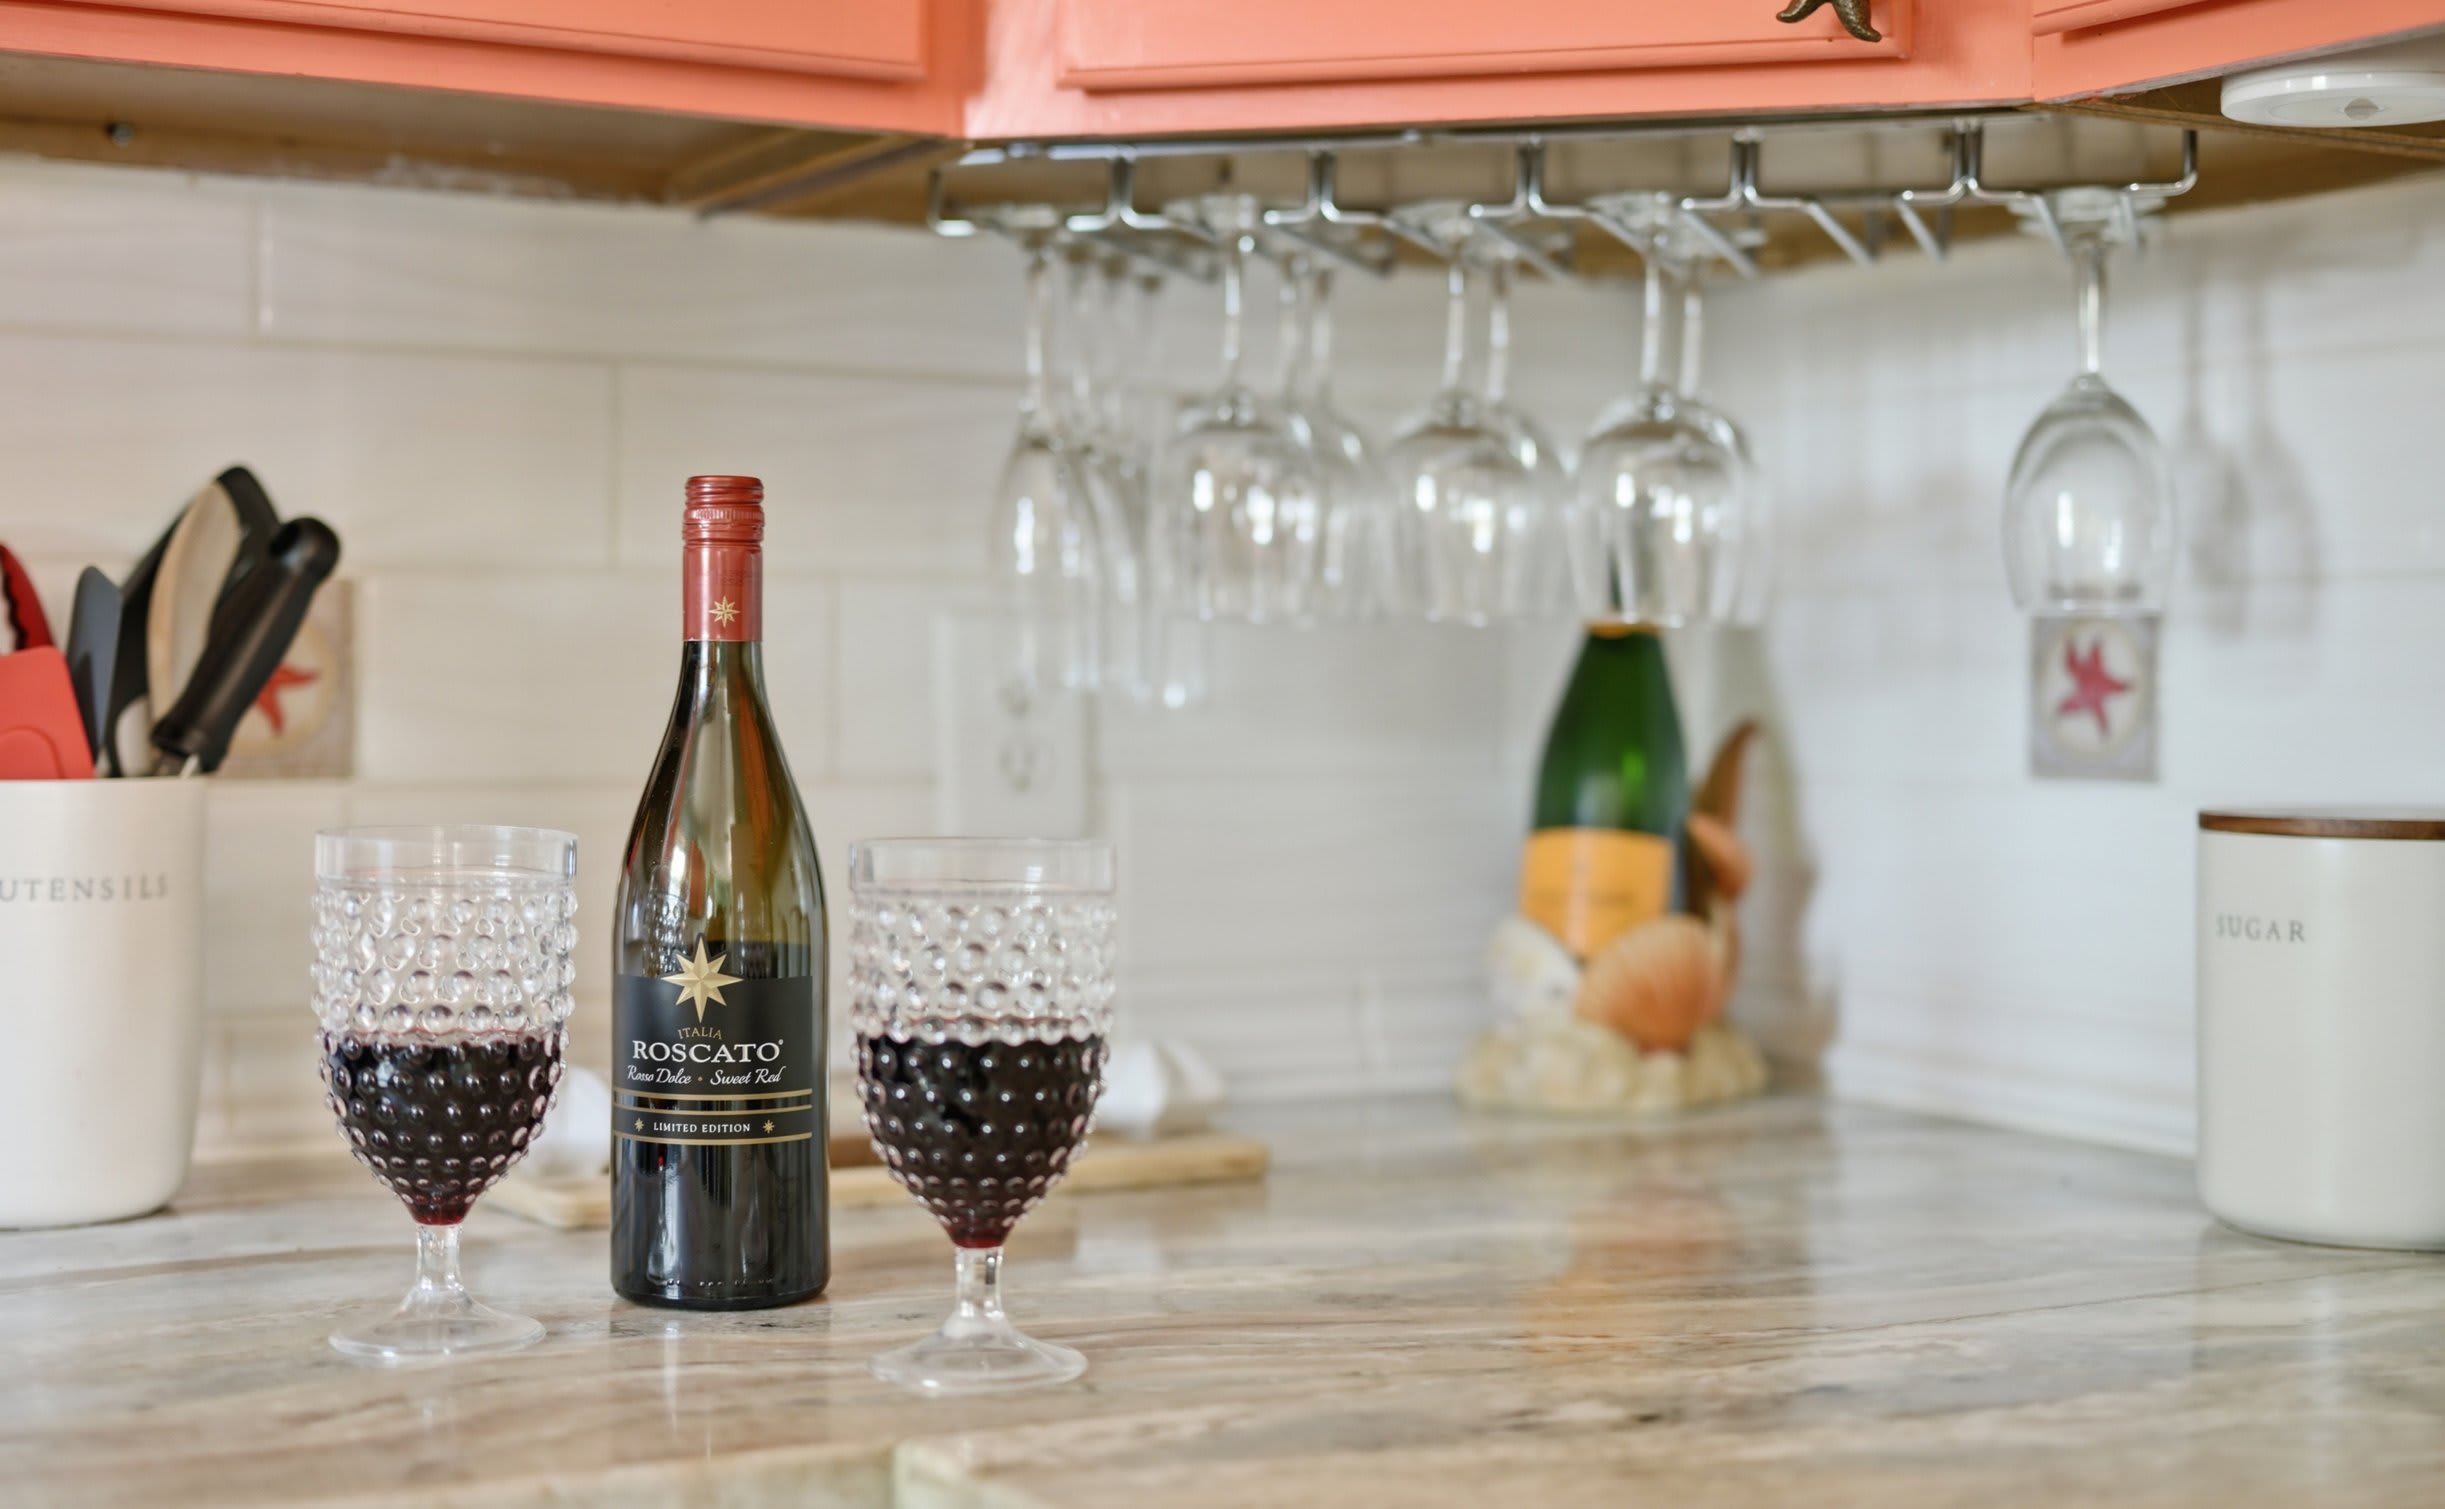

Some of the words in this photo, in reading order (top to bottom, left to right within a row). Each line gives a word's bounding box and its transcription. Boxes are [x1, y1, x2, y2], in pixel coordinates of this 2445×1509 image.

[0, 873, 168, 902] UTENSILS
[2216, 913, 2305, 942] SUGAR
[677, 1026, 722, 1040] ITALIA
[627, 1065, 654, 1081] Rosso
[656, 1067, 692, 1084] Dolce
[710, 1069, 752, 1085] Sweet
[755, 1065, 787, 1084] Red
[653, 1122, 697, 1133] LIMITED
[702, 1123, 750, 1133] EDITION
